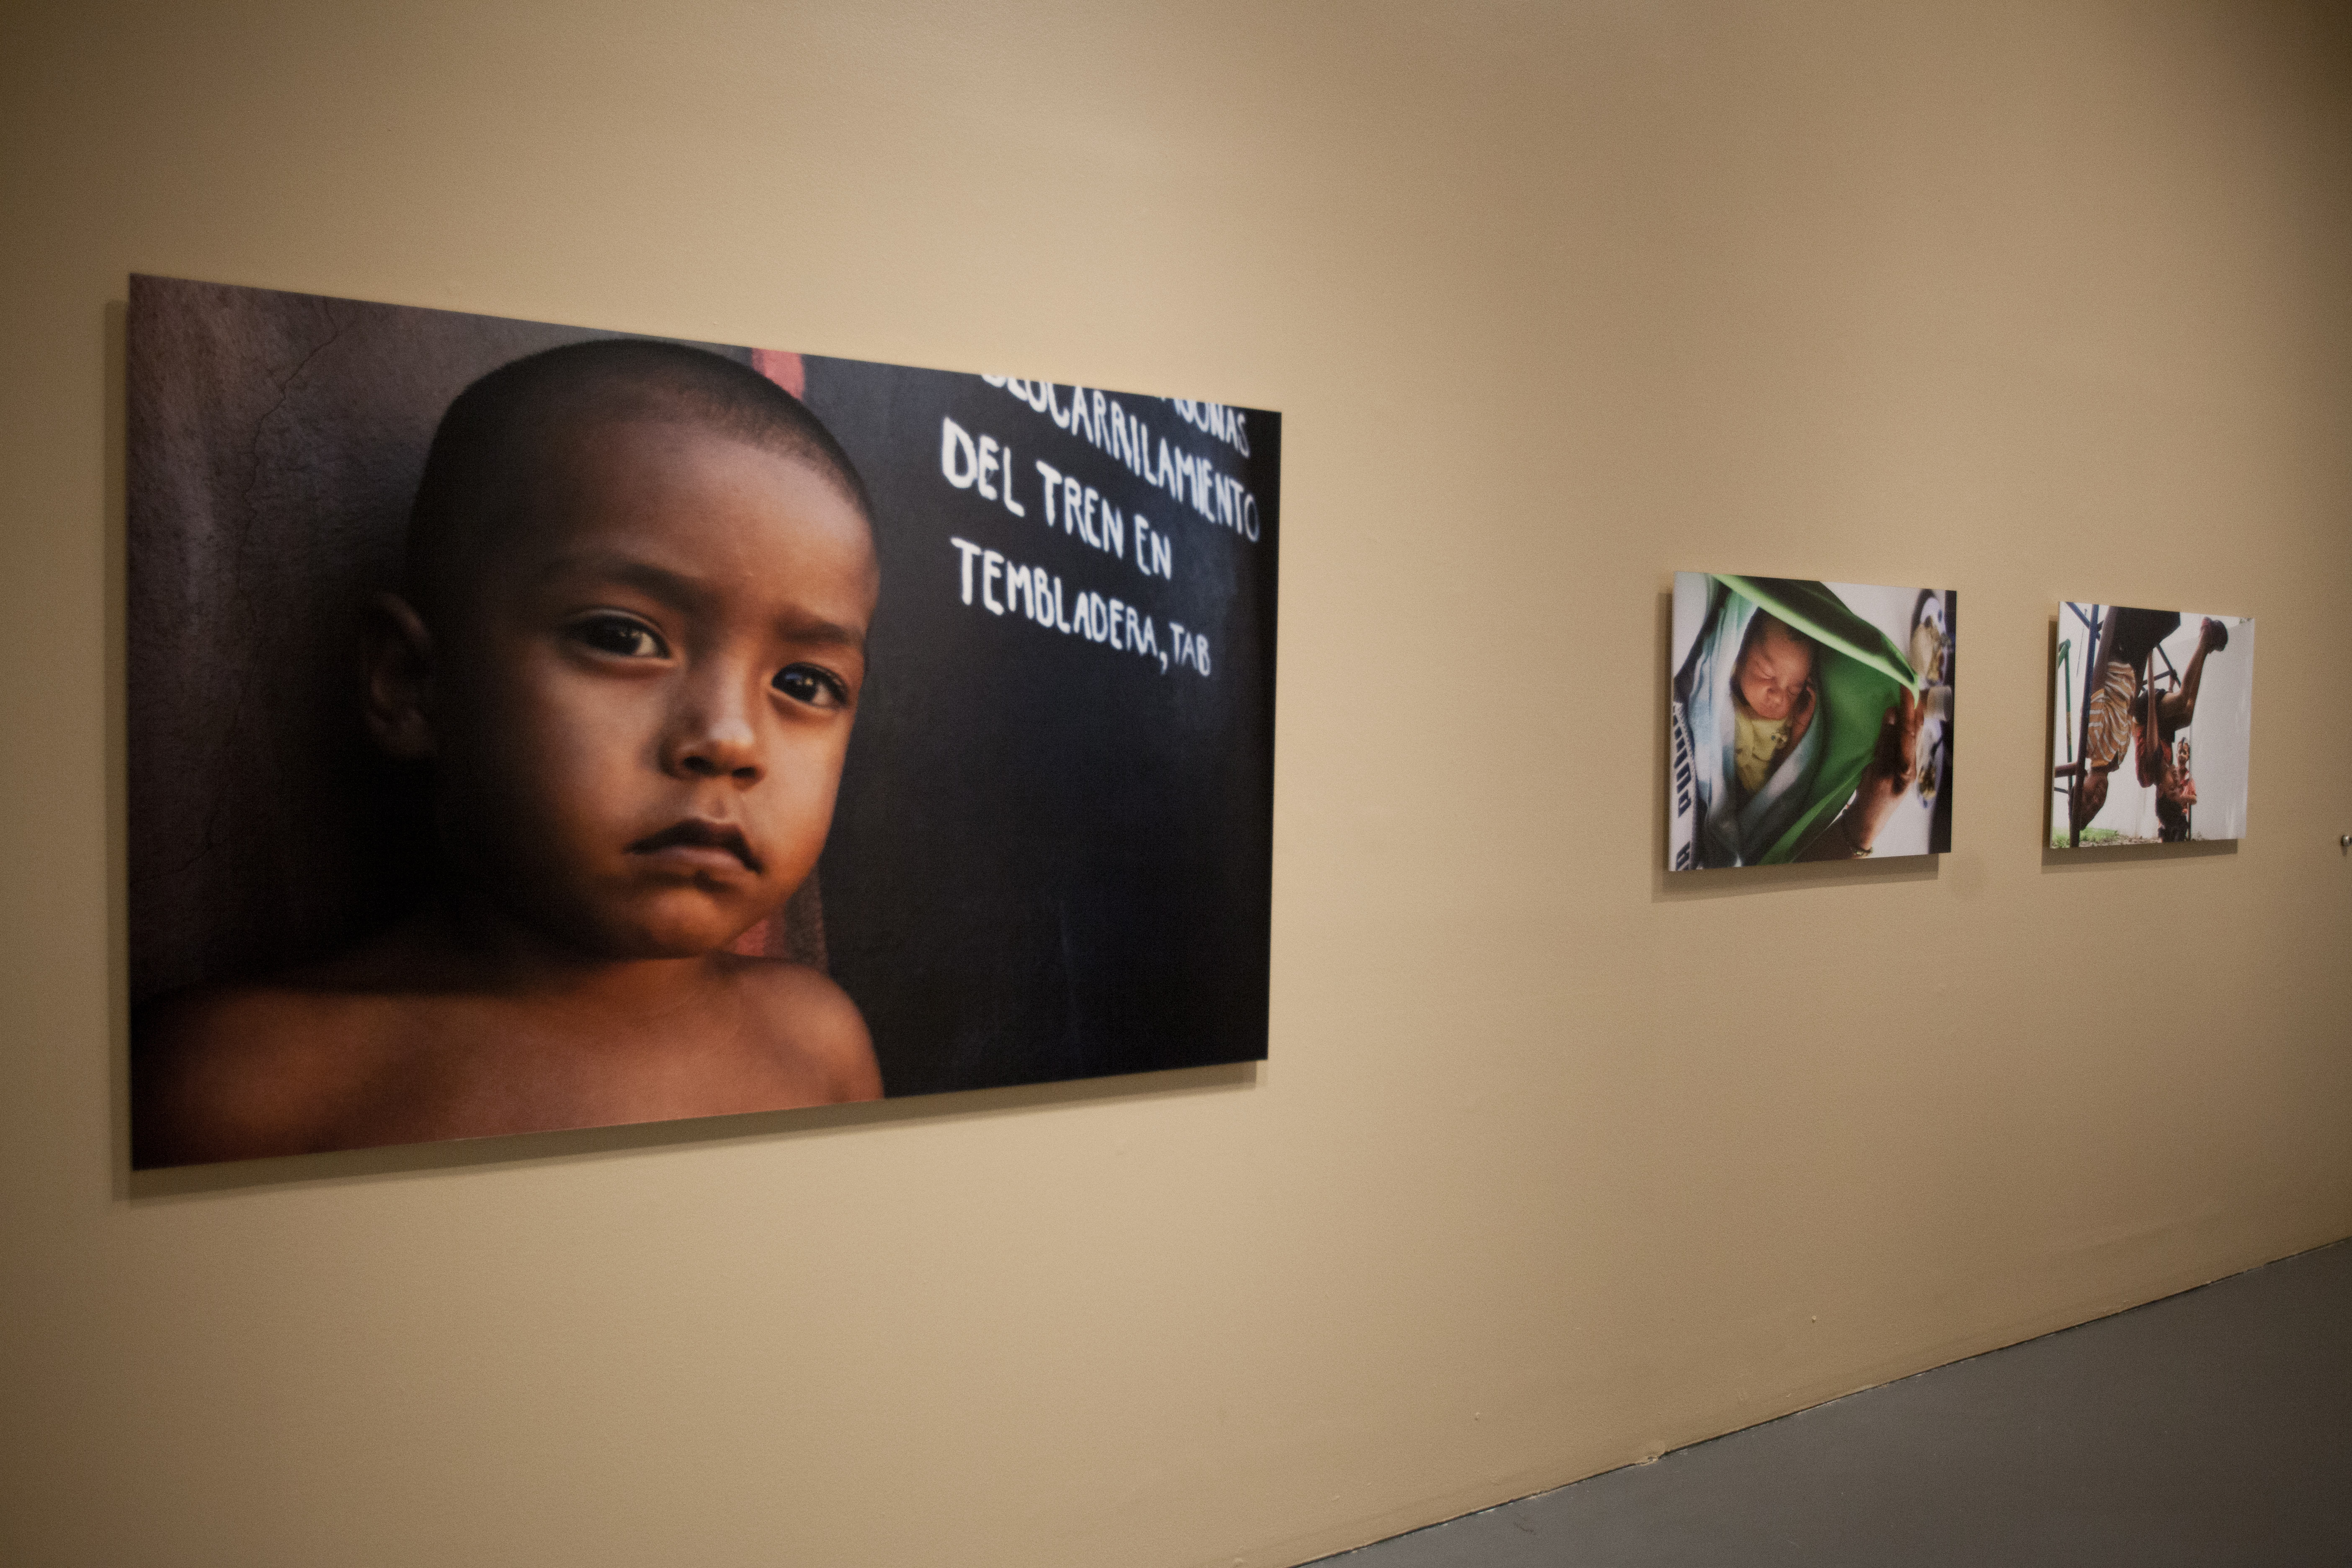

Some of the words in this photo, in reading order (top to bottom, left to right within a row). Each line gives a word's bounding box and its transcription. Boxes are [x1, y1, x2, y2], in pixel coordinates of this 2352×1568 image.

[941, 417, 1025, 518] DEL
[1035, 459, 1124, 560] TREN
[1134, 513, 1171, 581] EN
[950, 536, 1168, 675] TEMBLADERA,
[1169, 622, 1211, 677] TAB
